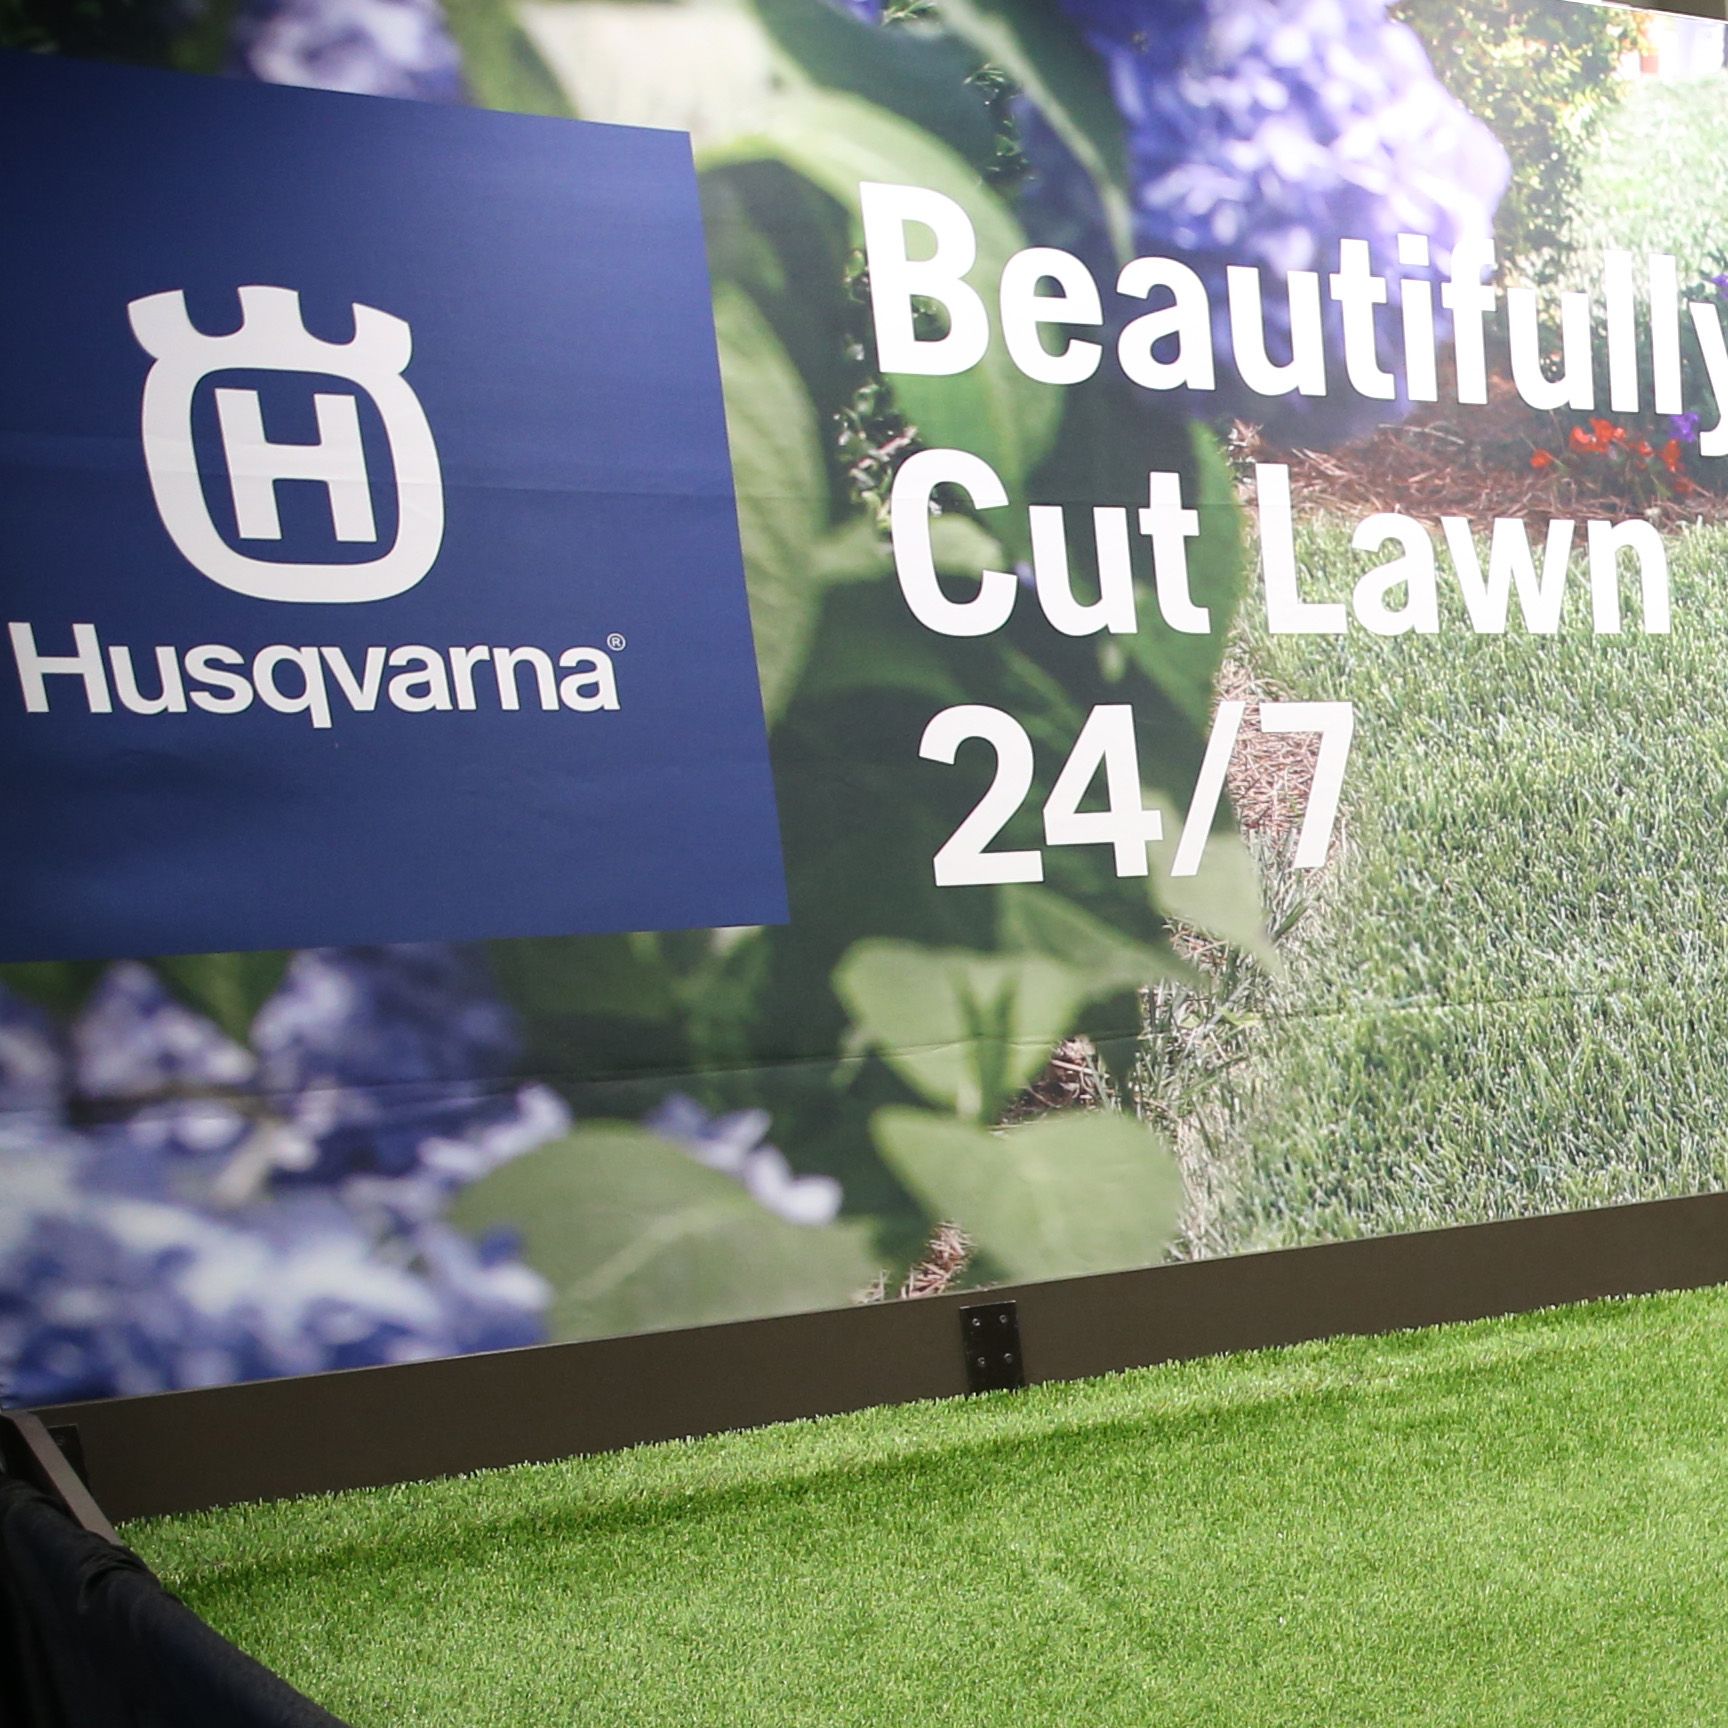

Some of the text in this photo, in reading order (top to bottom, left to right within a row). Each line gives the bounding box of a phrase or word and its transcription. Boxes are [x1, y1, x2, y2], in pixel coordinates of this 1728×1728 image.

[889, 449, 1671, 641] Cut Lawn
[8, 621, 622, 730] Husqvarna
[917, 697, 1355, 889] 24/7
